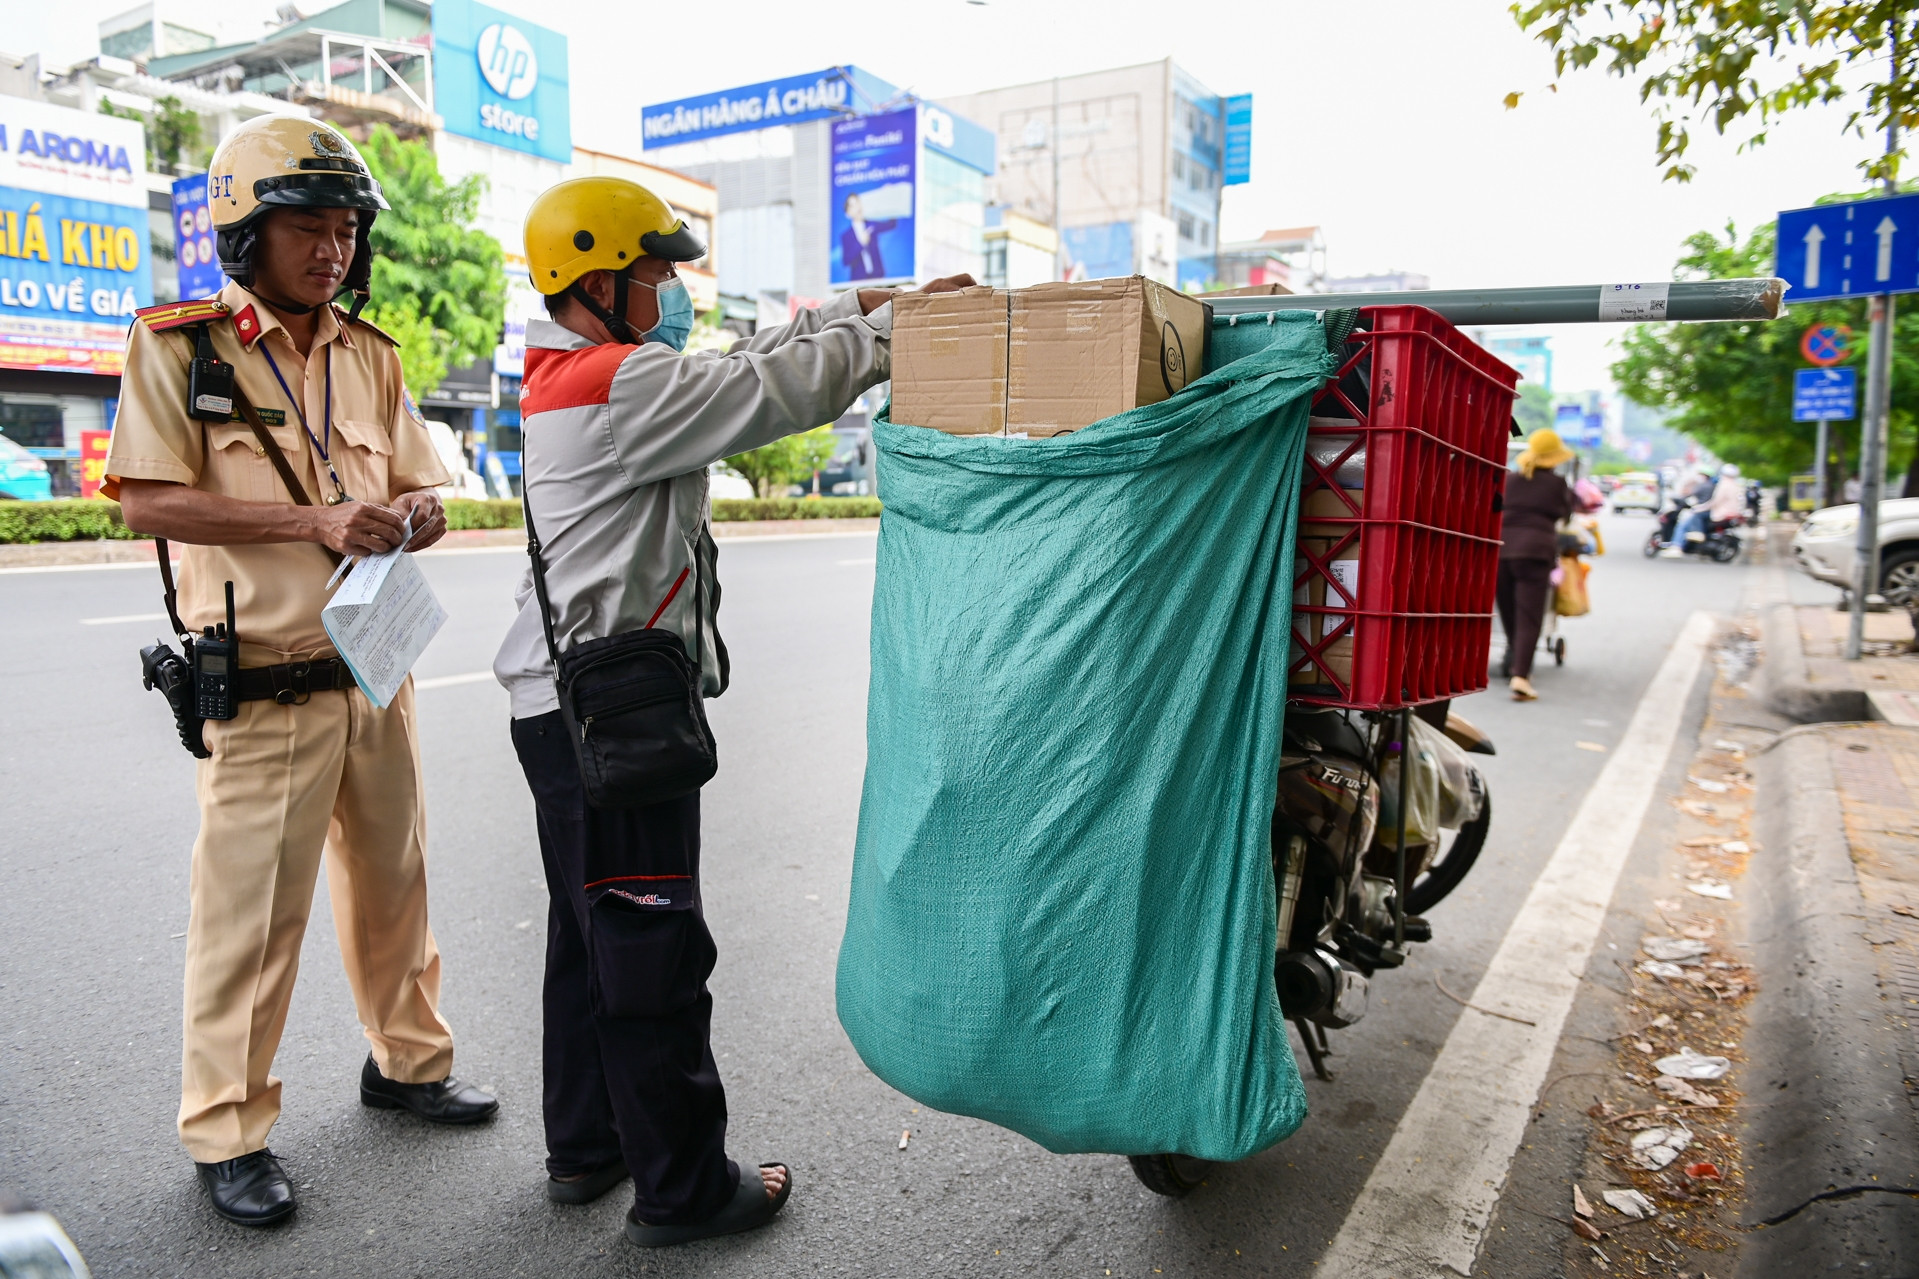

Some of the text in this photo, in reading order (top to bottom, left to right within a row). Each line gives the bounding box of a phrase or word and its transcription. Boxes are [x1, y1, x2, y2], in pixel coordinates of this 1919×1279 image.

[484, 22, 533, 99] hp
[481, 103, 539, 140] store
[644, 78, 848, 140] NGÂN HÀNG Á CHÂU
[17, 128, 132, 174] AROMA
[0, 201, 140, 273] IÁ KHO
[1, 276, 139, 318] LO VỀ GIÁ
